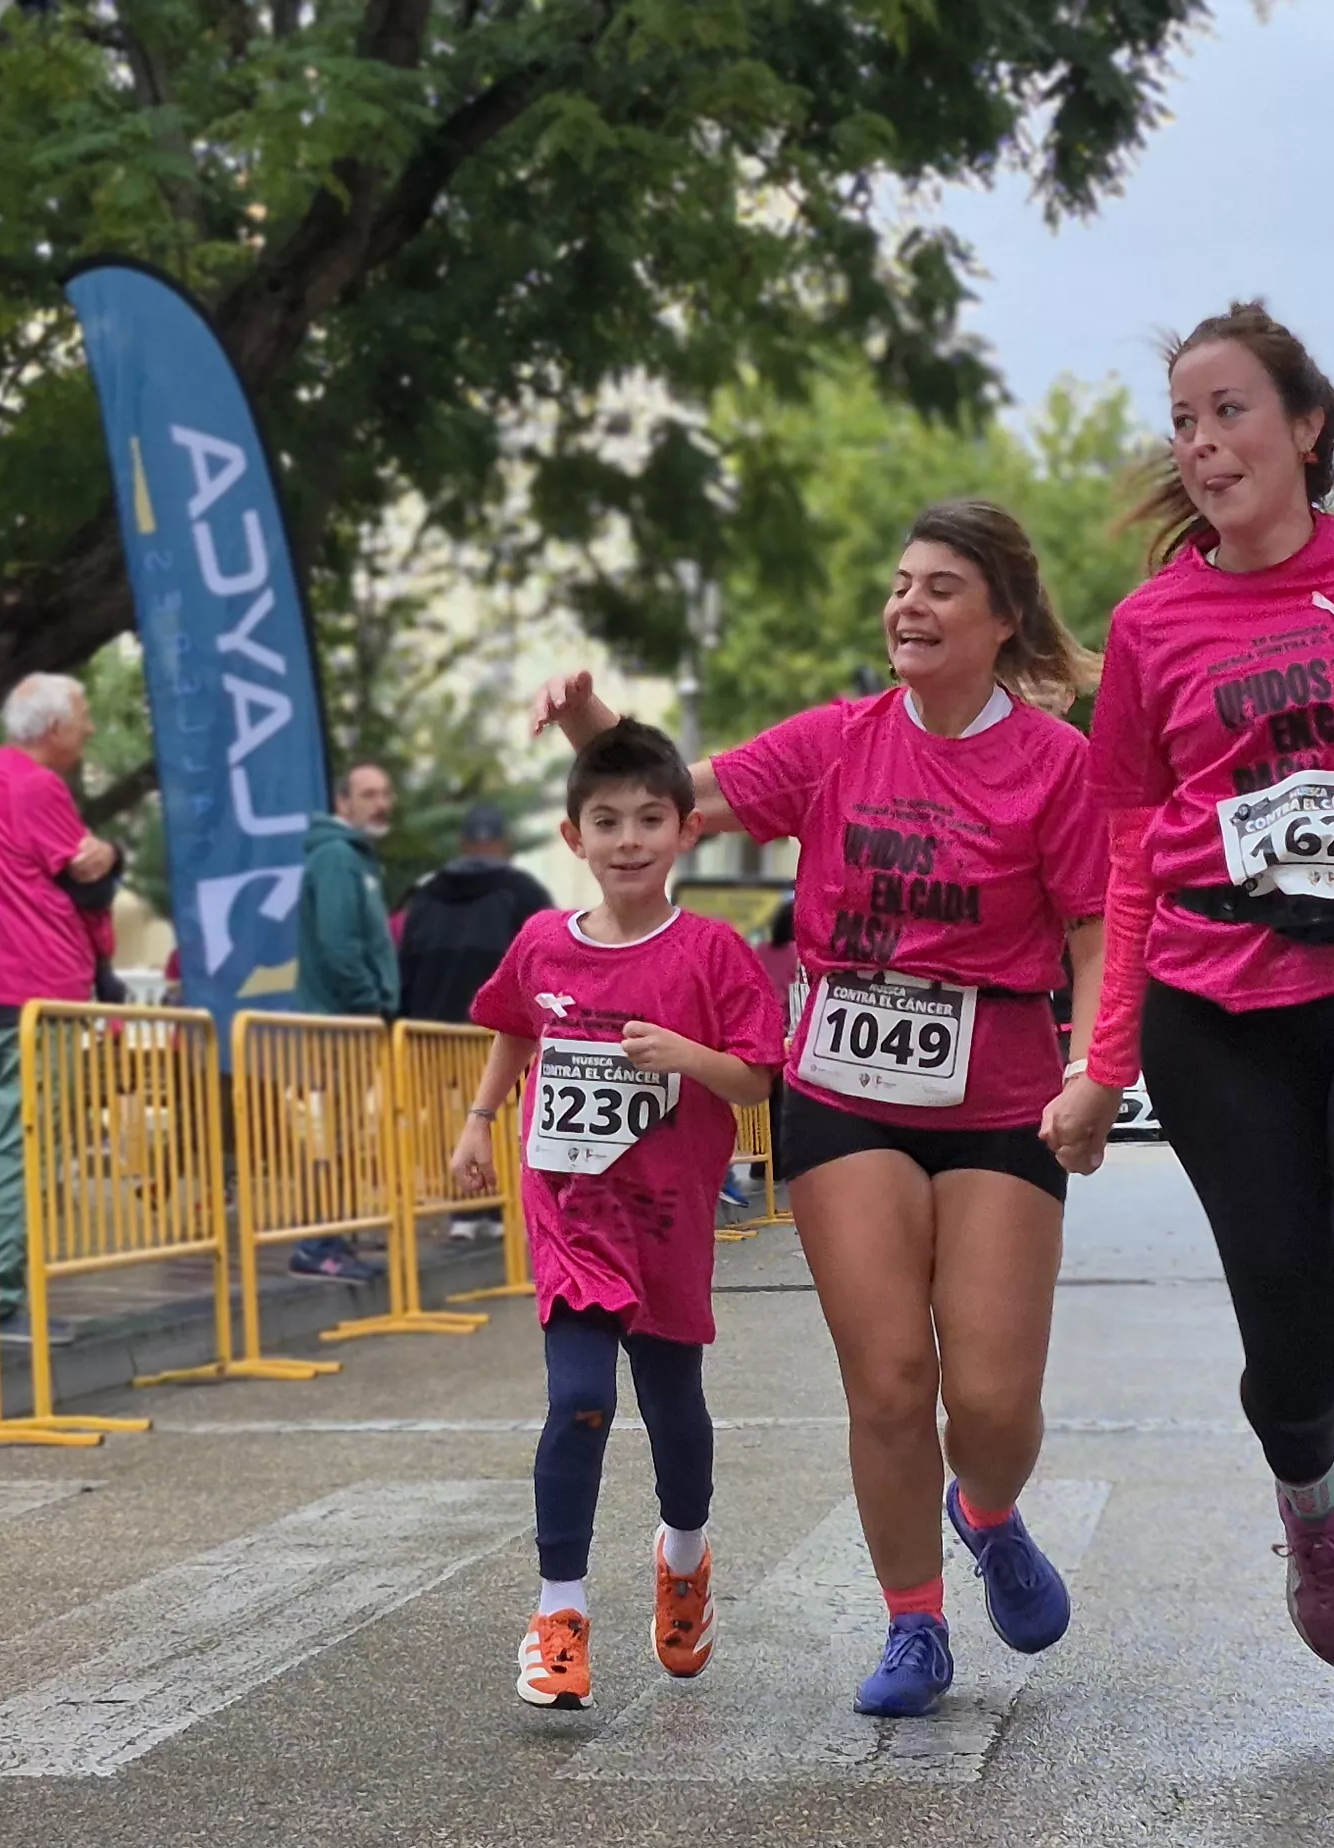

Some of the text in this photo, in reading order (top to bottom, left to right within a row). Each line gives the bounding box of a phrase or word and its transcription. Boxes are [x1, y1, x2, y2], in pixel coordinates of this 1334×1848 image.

[1303, 798, 1320, 810] EL
[833, 986, 953, 1016] CONTRA EL CÁNCER
[826, 1007, 951, 1069] 1049
[571, 1054, 614, 1067] HUESCA
[585, 1066, 601, 1080] EL
[603, 1065, 660, 1084] CÁNCER
[541, 1083, 660, 1138] 3230
